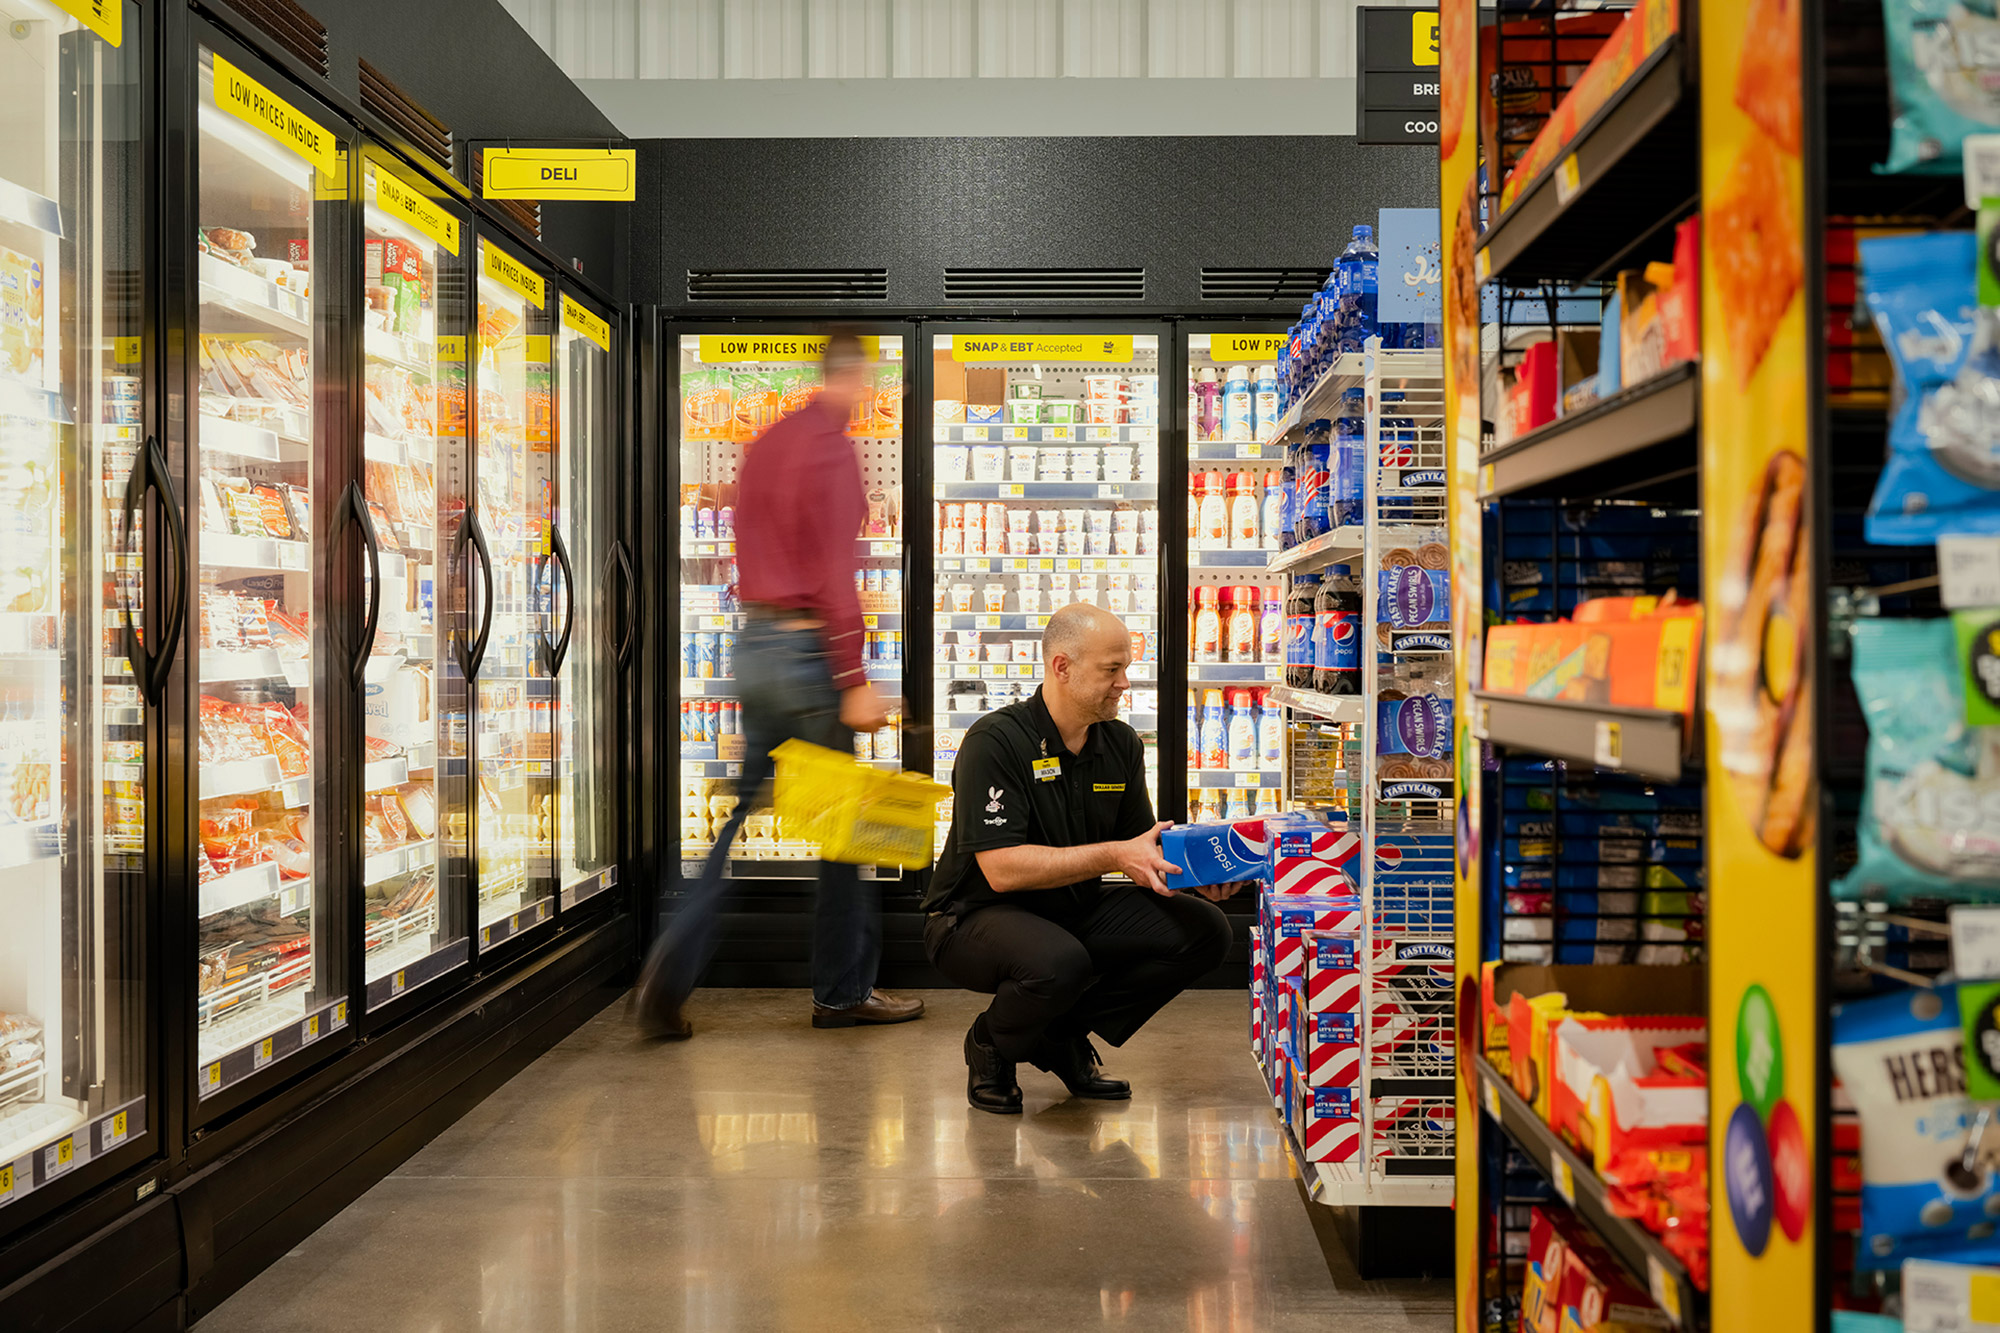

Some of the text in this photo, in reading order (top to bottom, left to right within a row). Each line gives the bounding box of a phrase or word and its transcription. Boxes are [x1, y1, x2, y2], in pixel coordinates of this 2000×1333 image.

[1412, 83, 1440, 96] BRE
[229, 76, 322, 156] LOW PRICES INSIDE.
[1404, 120, 1440, 134] COO
[540, 167, 578, 182] DELI
[381, 179, 400, 203] SNAP
[404, 195, 417, 215] EBT
[491, 252, 503, 273] LOW
[503, 261, 519, 284] PRICES
[1404, 255, 1441, 287] Ju
[720, 342, 828, 355] LOW PRICES INS
[964, 341, 1083, 355] SNAP & EBT Accepted
[1232, 339, 1261, 352] LOW
[883, 386, 901, 398] COM
[884, 392, 901, 404] PAC
[1404, 472, 1446, 486] TASTYKA
[1387, 566, 1404, 628] TASTYKAKE
[1407, 569, 1419, 623] PECAN SWIRLS
[1396, 635, 1450, 650] TASTYKAKE
[1412, 699, 1426, 753] PECAN SWIRLS
[1426, 693, 1446, 758] TASTYKAKE
[1386, 782, 1438, 797] TASTYKAKE
[1207, 836, 1237, 873] pepsi
[1400, 944, 1455, 959] TASTYKAKE
